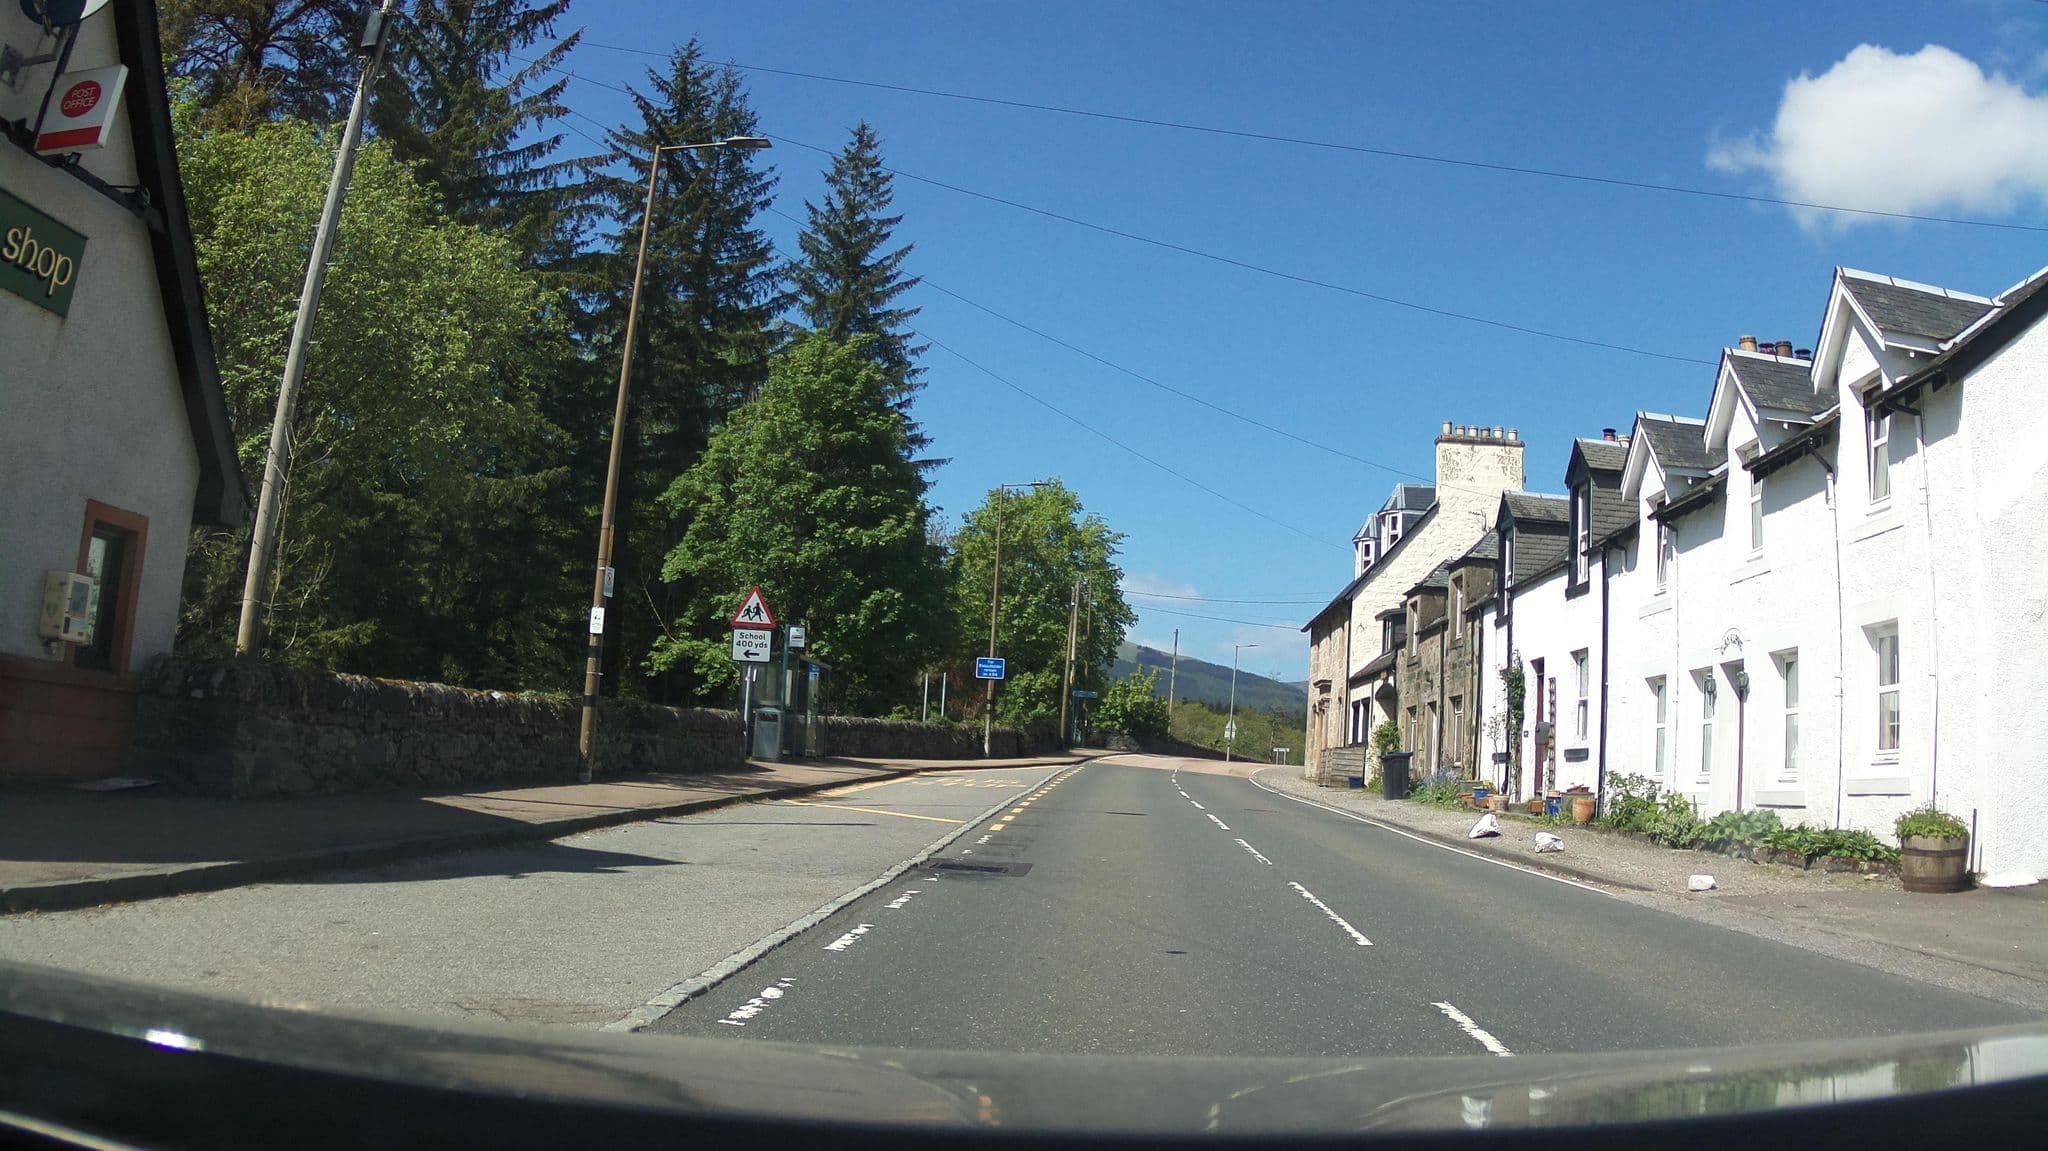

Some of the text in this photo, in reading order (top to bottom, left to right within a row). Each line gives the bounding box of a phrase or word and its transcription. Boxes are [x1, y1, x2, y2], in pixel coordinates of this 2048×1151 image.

[72, 86, 97, 98] POST
[63, 97, 97, 110] OFFICE
[2, 226, 73, 295] shop
[739, 632, 766, 640] School
[735, 640, 768, 649] 400 yds
